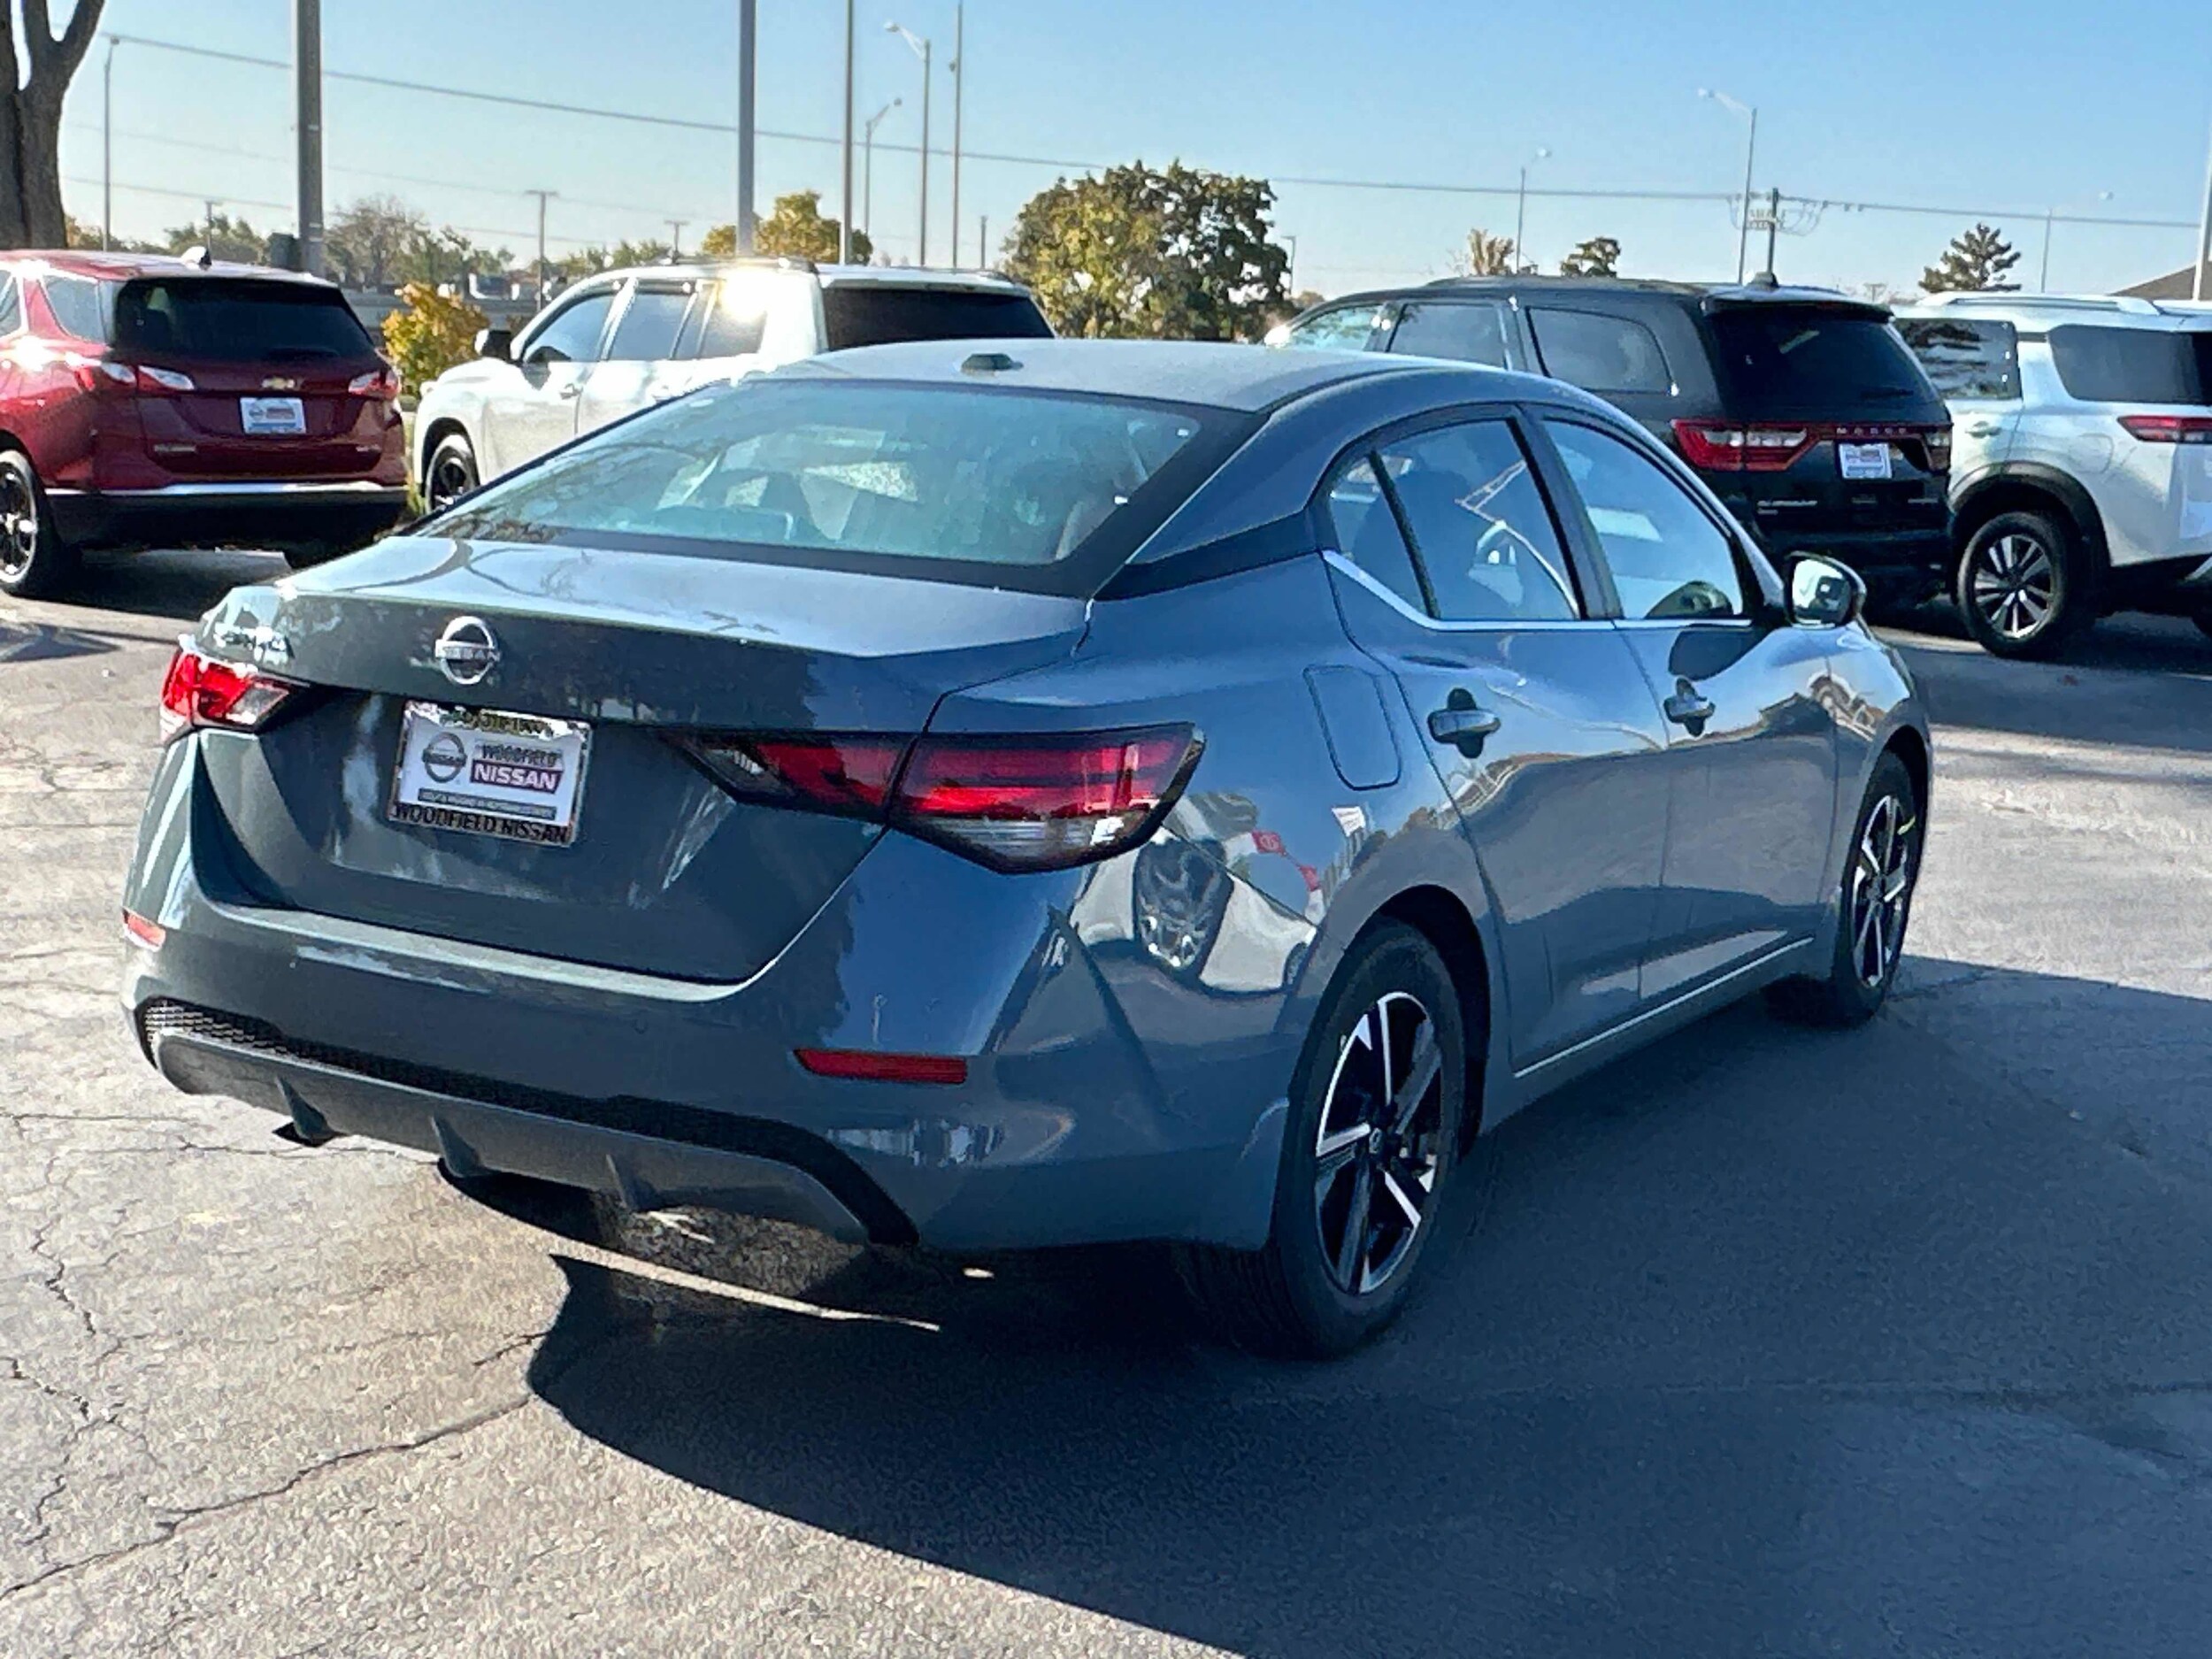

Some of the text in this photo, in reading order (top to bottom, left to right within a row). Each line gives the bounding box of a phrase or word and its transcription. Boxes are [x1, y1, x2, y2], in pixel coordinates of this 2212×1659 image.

[474, 763, 557, 791] NISSAN
[392, 803, 497, 833] WOODFIELD
[501, 818, 569, 842] NISSAN
